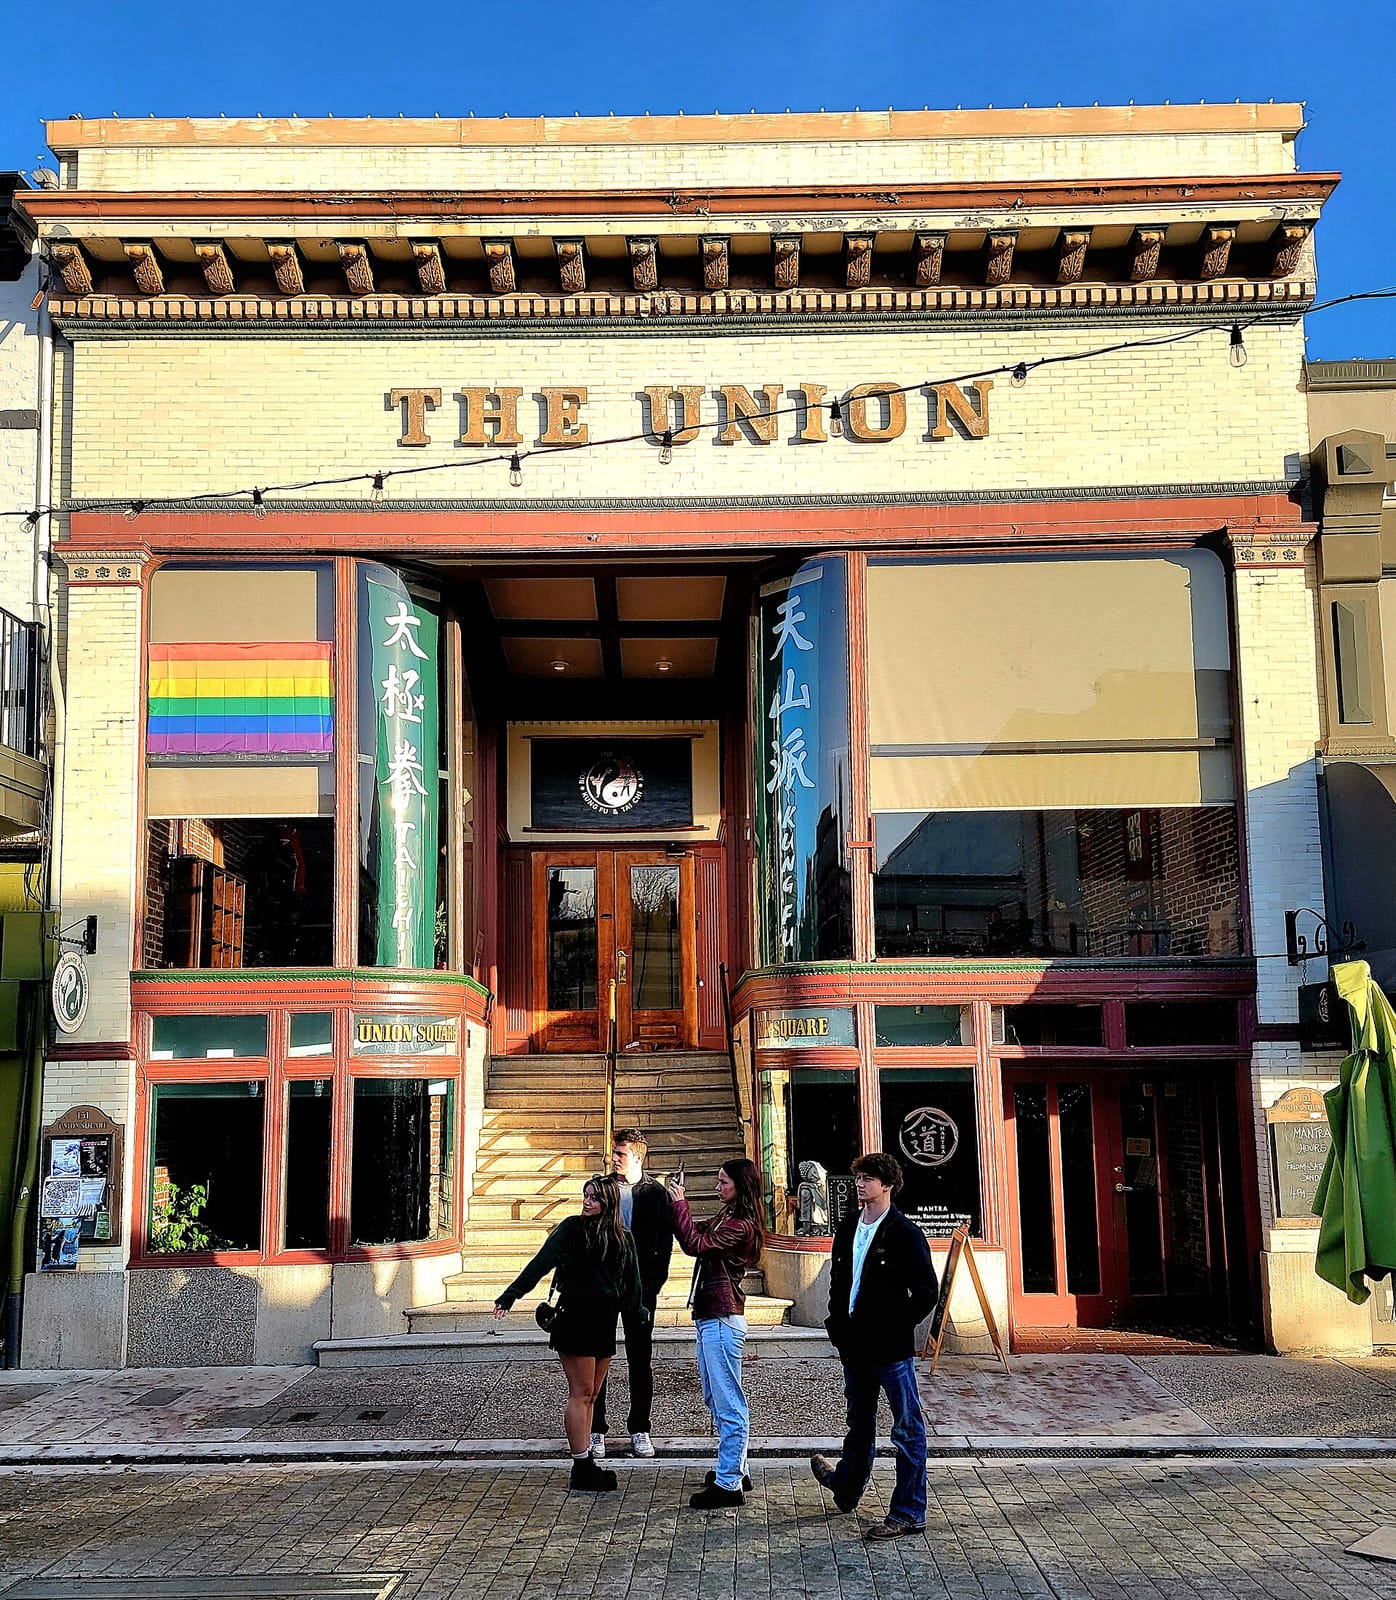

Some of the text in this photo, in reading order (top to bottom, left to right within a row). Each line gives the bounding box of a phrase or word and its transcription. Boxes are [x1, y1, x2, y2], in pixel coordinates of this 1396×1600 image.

[385, 379, 995, 447] THE UNION
[381, 601, 429, 809] 太極拳
[767, 595, 815, 794] 天山派
[581, 791, 599, 810] KUNG
[598, 807, 609, 815] FU
[620, 802, 633, 813] TAI
[631, 790, 643, 804] CHI
[781, 805, 796, 948] KUNG FU
[358, 1024, 414, 1042] UNION
[772, 1017, 829, 1041] SQUARE
[77, 1111, 89, 1119] 151
[910, 1123, 947, 1160] 道
[1293, 1126, 1331, 1140] MANTRA
[1298, 1143, 1327, 1154] HOURS
[837, 1182, 847, 1222] OPE
